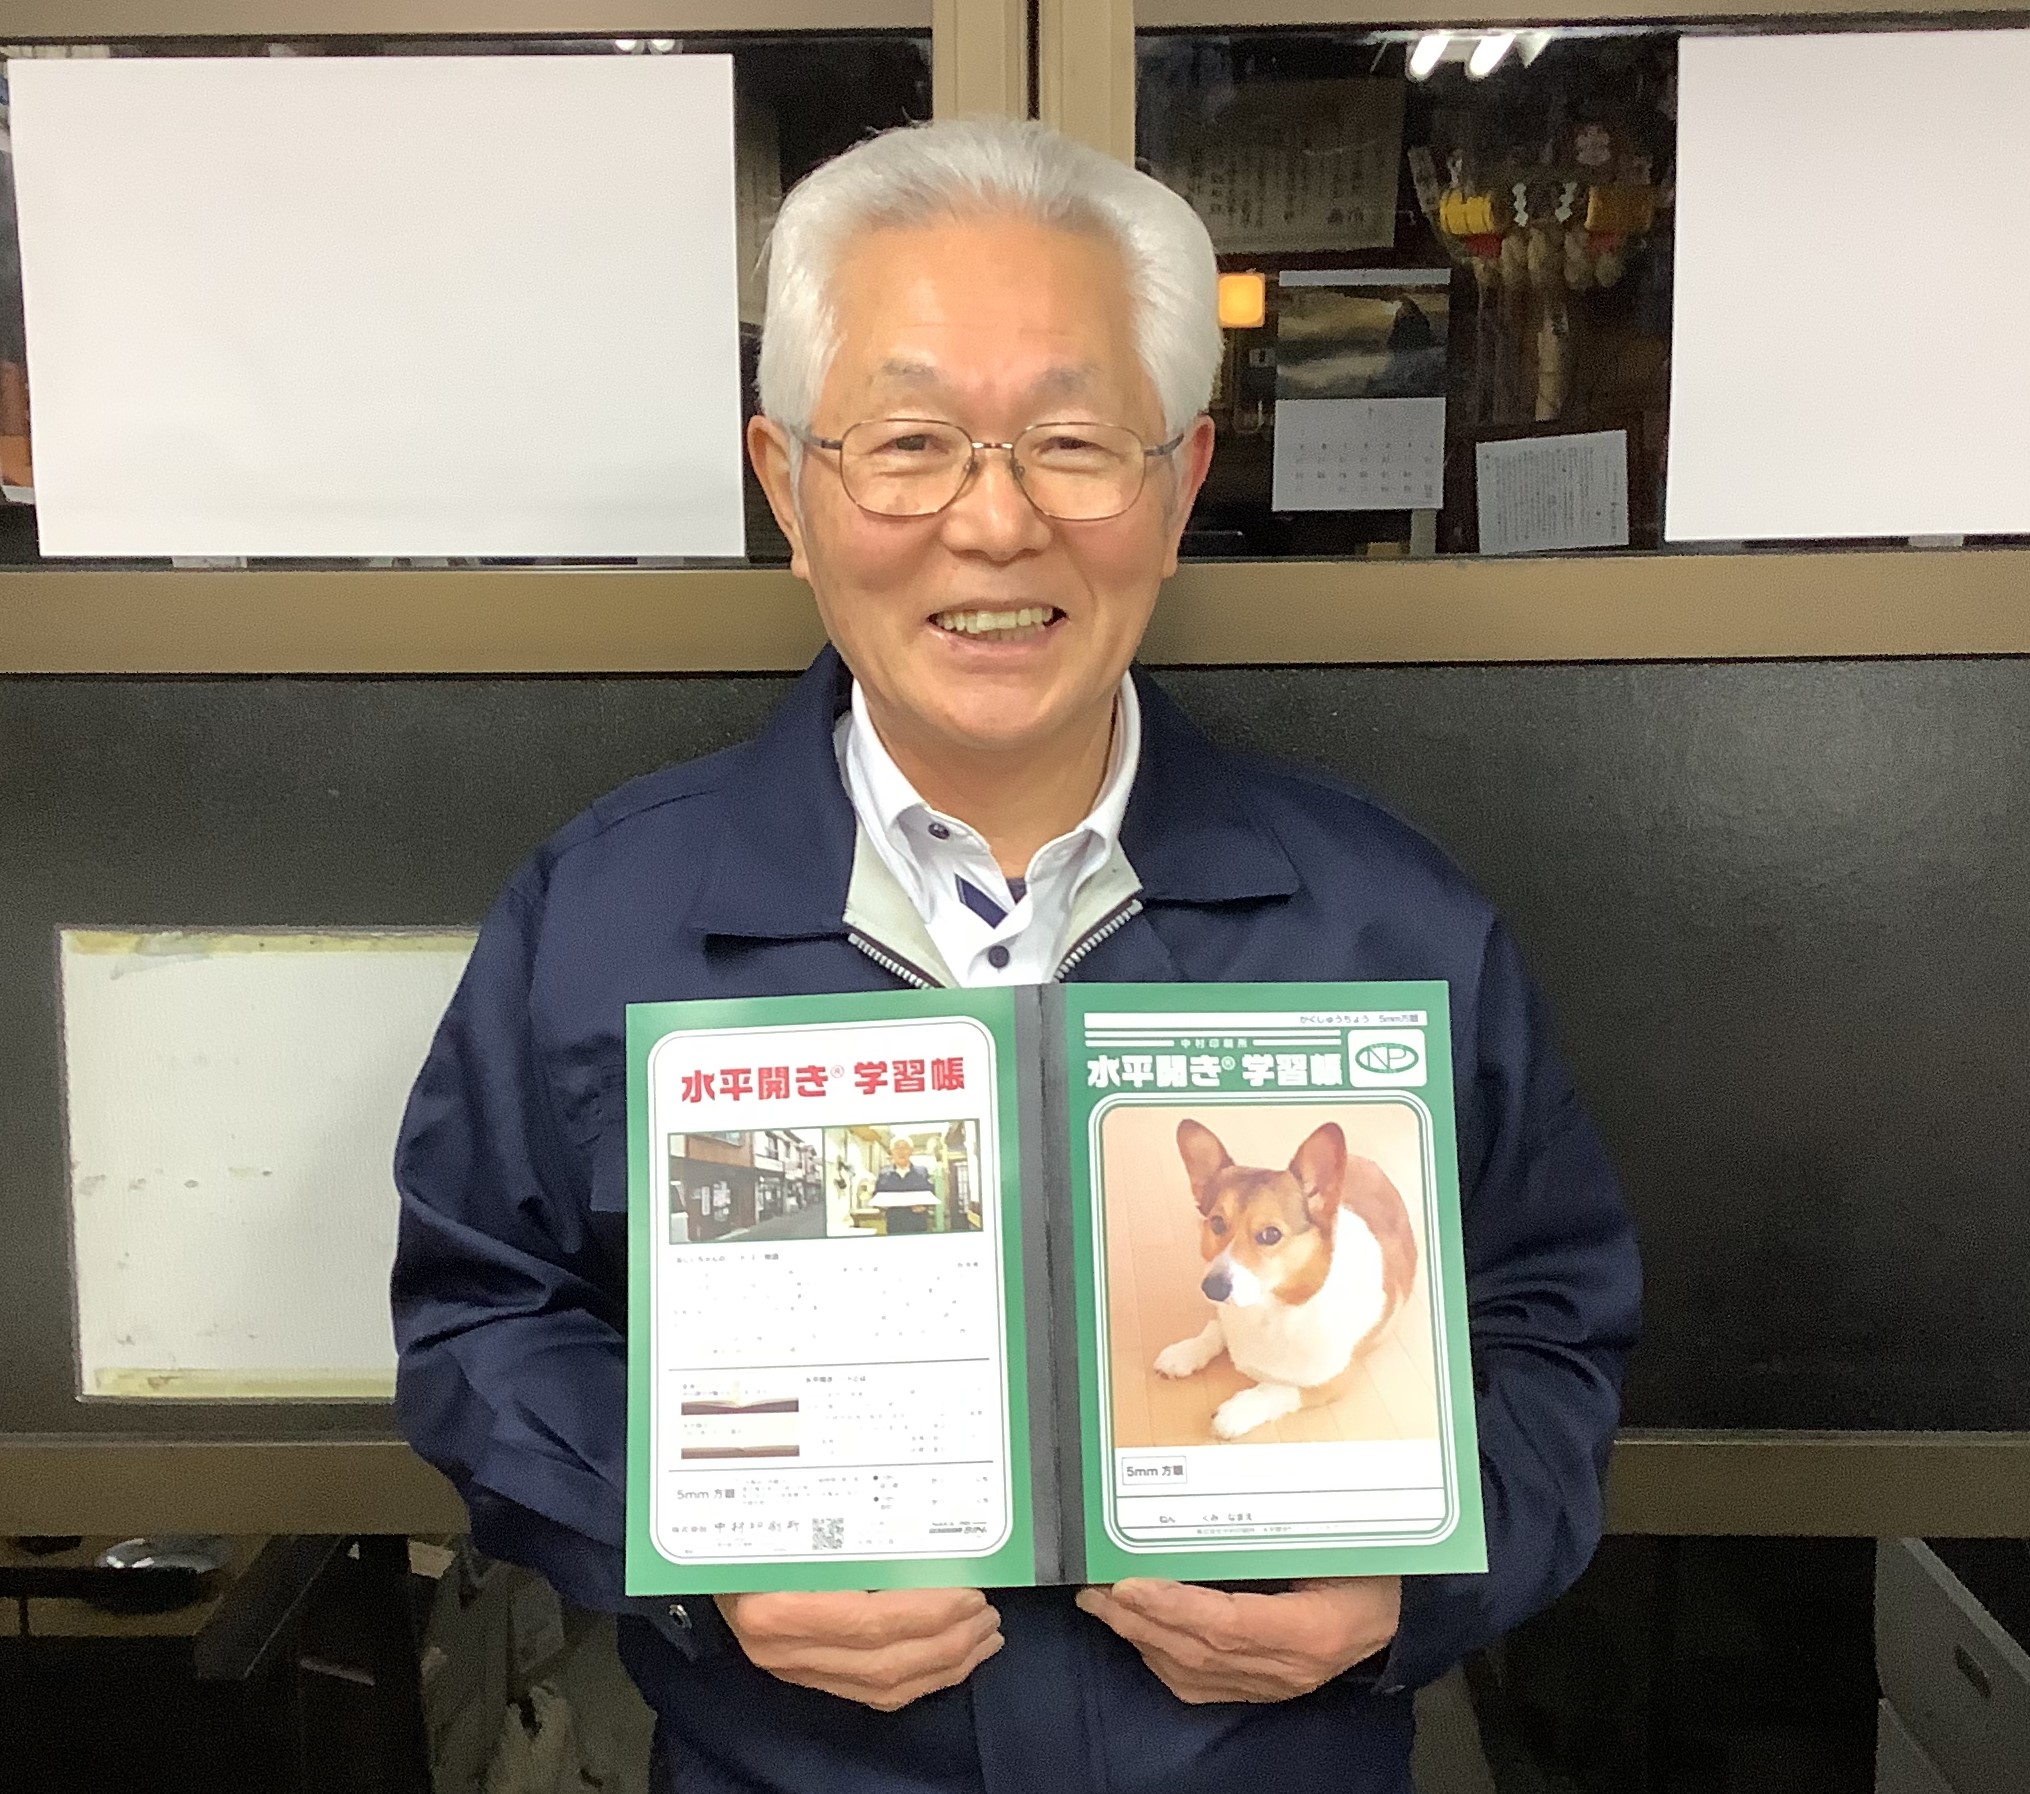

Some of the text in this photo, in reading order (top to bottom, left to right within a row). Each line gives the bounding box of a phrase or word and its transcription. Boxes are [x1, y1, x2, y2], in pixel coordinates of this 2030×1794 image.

[1362, 1046, 1410, 1071] NP
[853, 1056, 965, 1096] 学習帳
[1126, 1466, 1158, 1477] 5mm
[677, 1489, 709, 1500] 5mm
